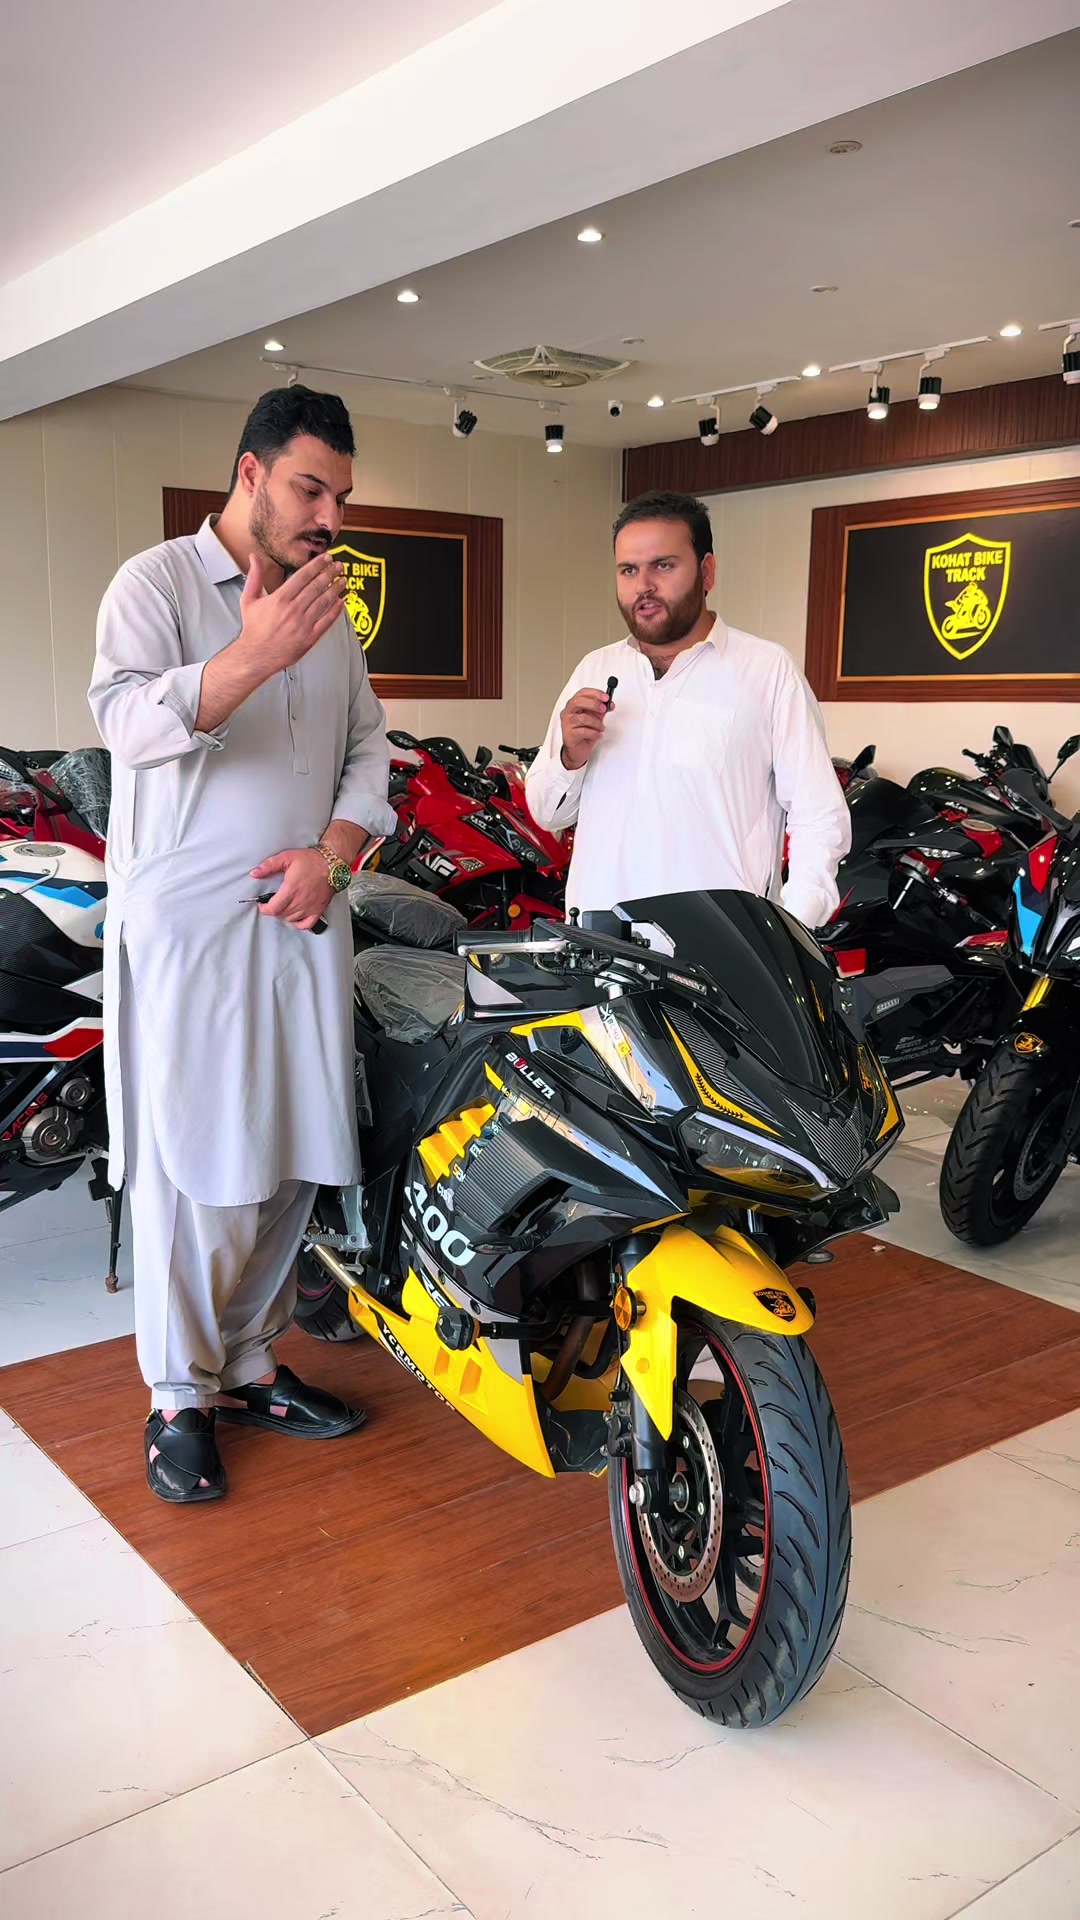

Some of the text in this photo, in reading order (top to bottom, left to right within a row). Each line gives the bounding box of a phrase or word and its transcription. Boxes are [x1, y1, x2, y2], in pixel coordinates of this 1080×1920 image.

[931, 550, 1004, 569] KOHAT BIKE
[352, 563, 379, 577] BIKE
[945, 566, 987, 583] TRACK
[404, 1181, 476, 1266] 400
